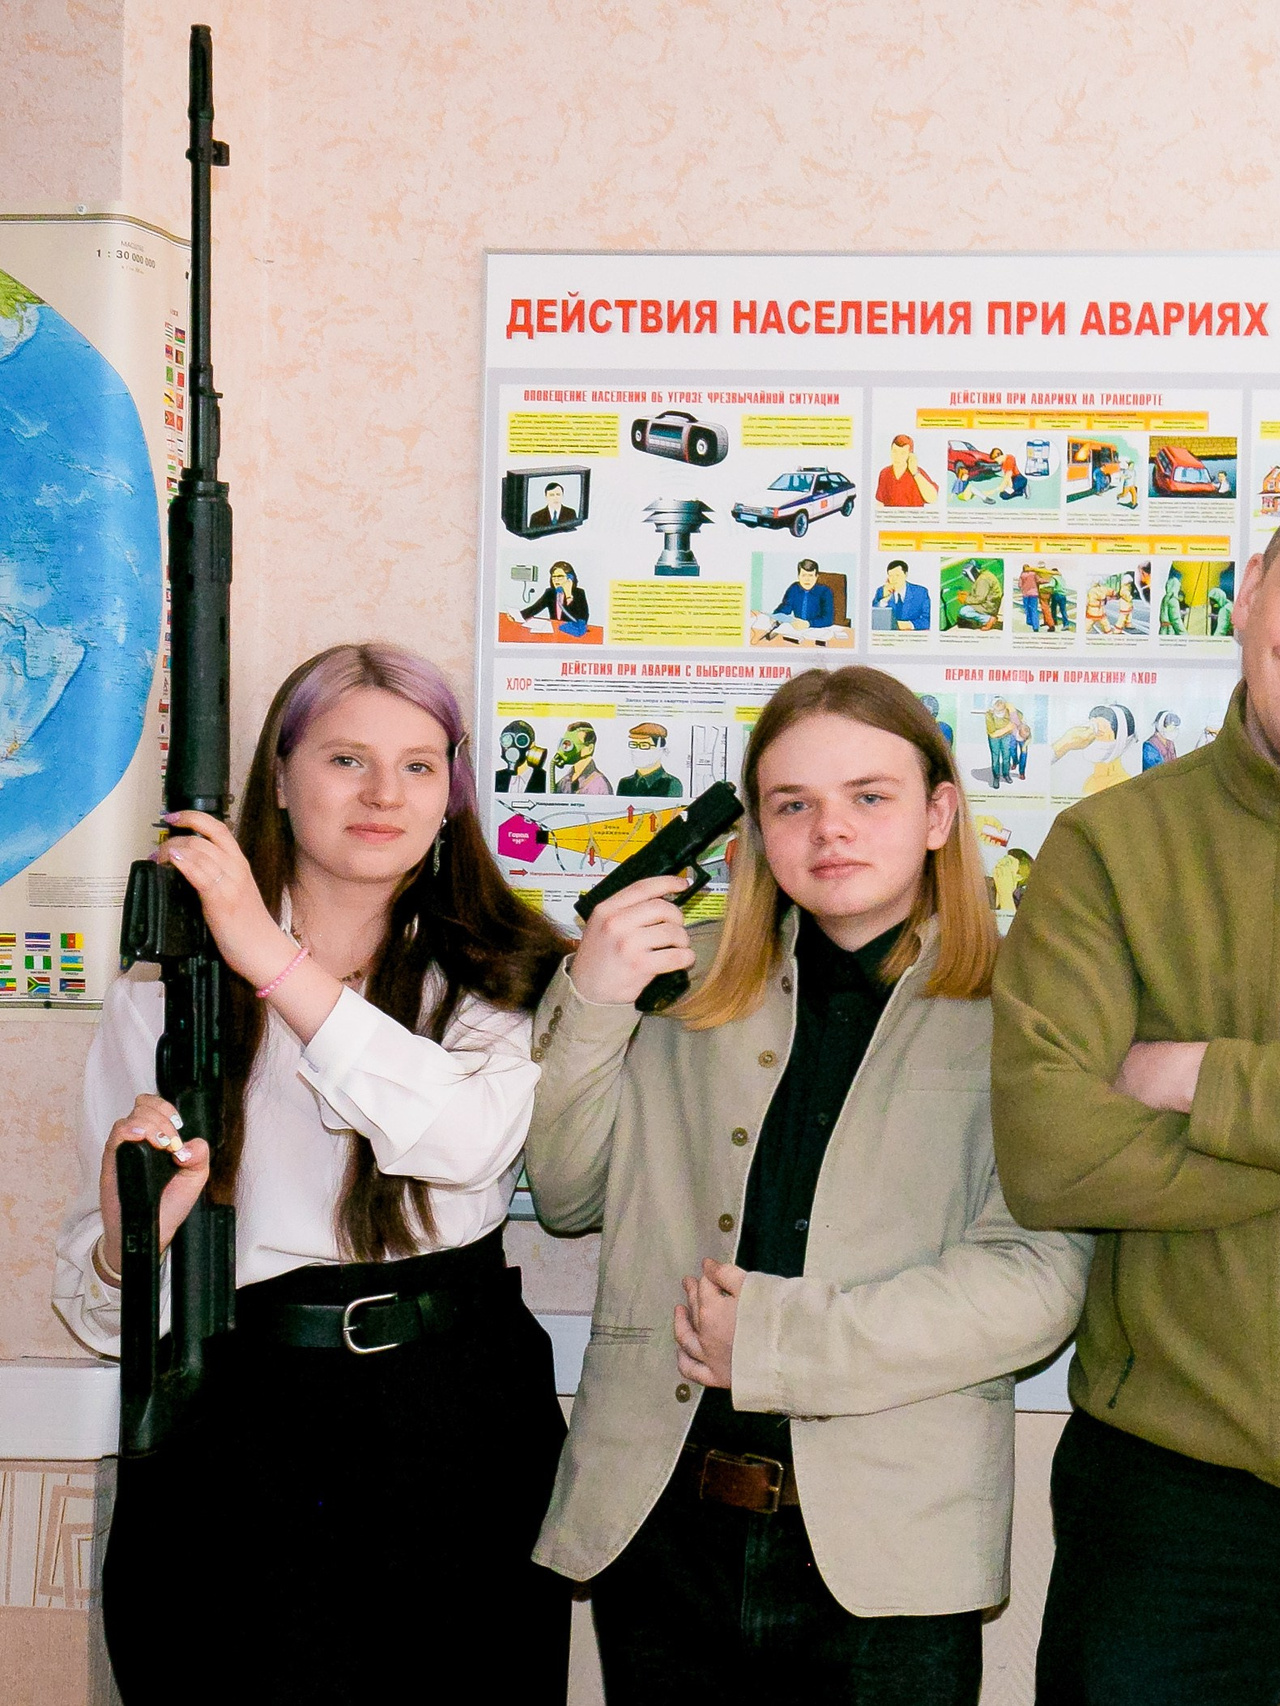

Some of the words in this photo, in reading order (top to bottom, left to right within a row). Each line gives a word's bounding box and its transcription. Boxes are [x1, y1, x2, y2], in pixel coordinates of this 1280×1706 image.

[116, 249, 130, 260] 30
[506, 291, 717, 340] ДЕЙСТВИЯ
[733, 299, 972, 336] НАСЕЛЕНИЯ
[987, 300, 1067, 337] ПРИ
[1080, 300, 1269, 337] АВАРИЯХ
[524, 389, 586, 403] ОПОВЕЩЕНИЕ
[592, 391, 647, 403] НАСЕЛЕНИЯ
[651, 391, 663, 403] ОБ
[668, 392, 702, 404] УГРОЗЕ
[708, 391, 785, 405] ЧРЕЗВЫЧАЙНОЙ
[790, 392, 840, 406] СИТУАЦИИ
[949, 391, 1002, 406] ДЕЙСТВИЯ
[1007, 392, 1027, 405] ПРИ
[1031, 393, 1077, 406] АВАРИЯХ
[1082, 393, 1095, 405] НА
[1100, 393, 1164, 406] ТРАНСПОРТЕ
[561, 661, 613, 676] ДЕЙСТВИЯ
[617, 663, 637, 676] ПРИ
[641, 664, 681, 677] АВАРИИ
[685, 665, 692, 677] С
[696, 665, 755, 679] ВЫБРОСОМ
[759, 667, 792, 679] ХЛОРА
[945, 668, 984, 681] ПЕРВАЯ
[988, 669, 1035, 684] ПОМОЩЬ
[1039, 670, 1059, 683] ПРИ
[1063, 671, 1126, 684] ПОРАЖЕНИИ
[1131, 672, 1157, 684] АХОВ
[506, 678, 532, 690] ХЛОР
